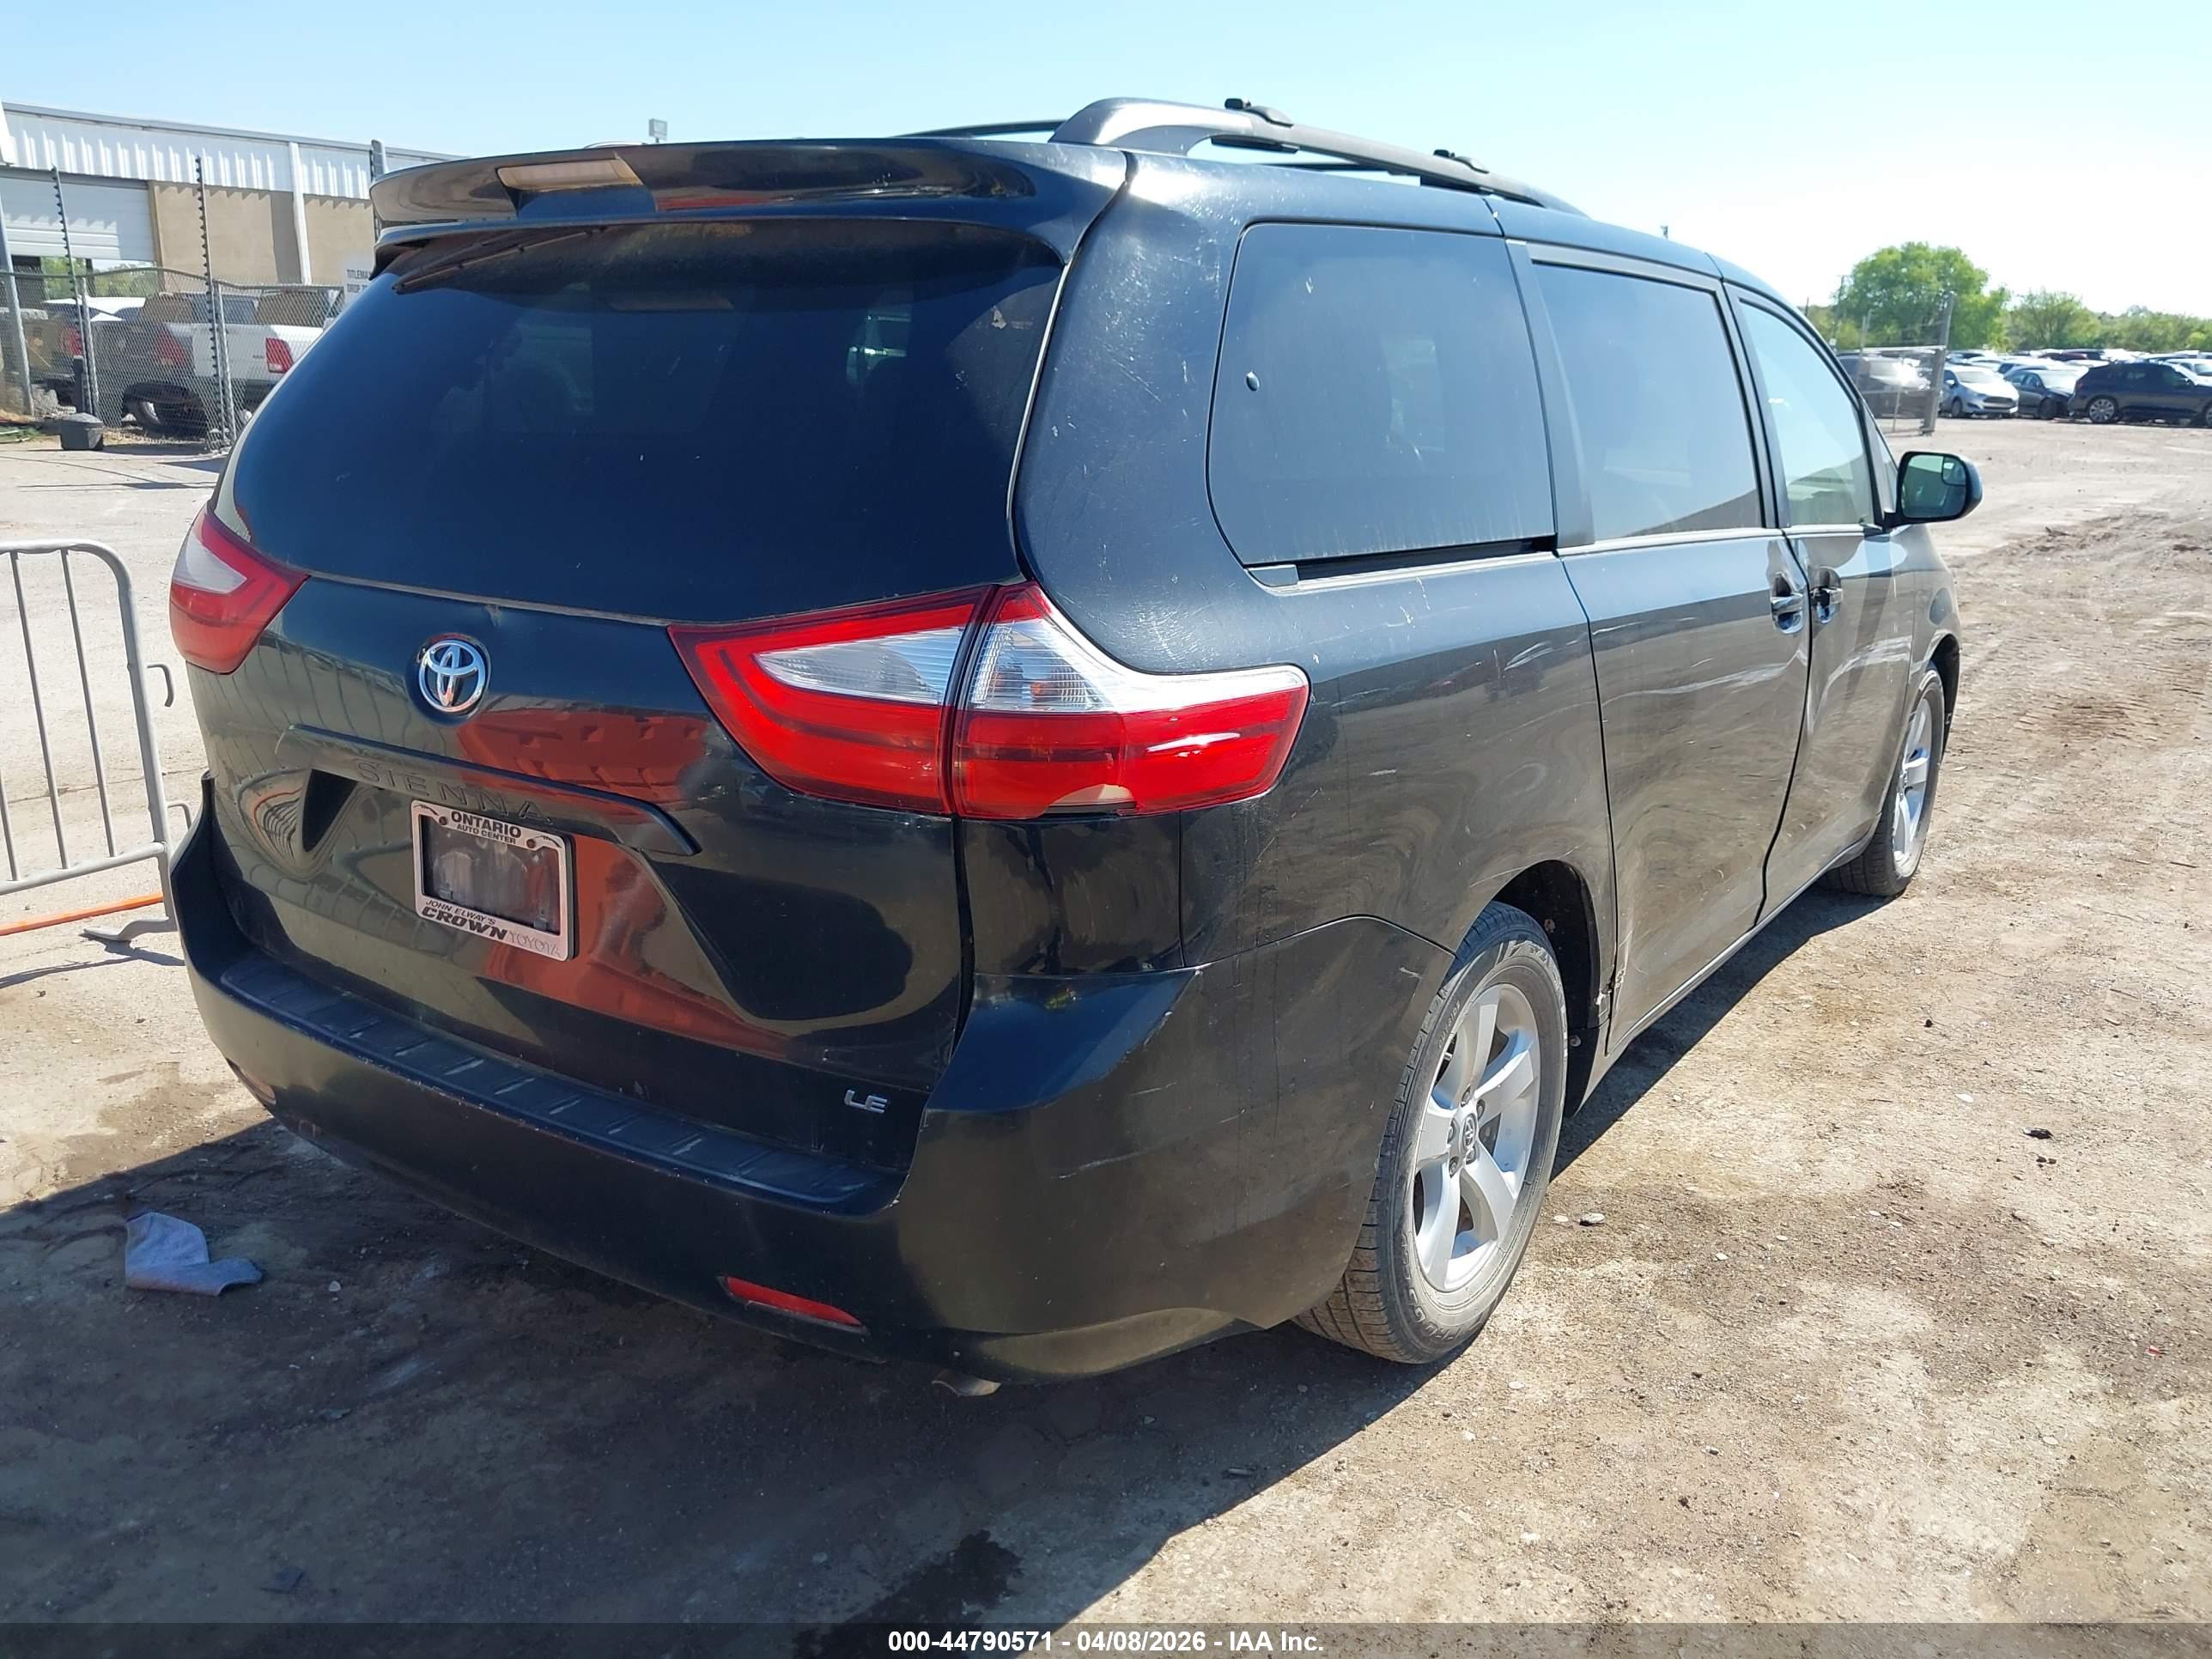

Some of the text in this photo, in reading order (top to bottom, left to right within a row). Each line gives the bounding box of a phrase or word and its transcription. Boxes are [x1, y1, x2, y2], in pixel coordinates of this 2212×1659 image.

[357, 763, 552, 825] SIENNA
[451, 811, 521, 838] ONTARIO
[456, 823, 516, 845] AUTO CENTER
[425, 899, 496, 925] JOHN ELWAY'S
[422, 906, 562, 957] CROWN TOYOTA
[844, 1089, 888, 1114] LE
